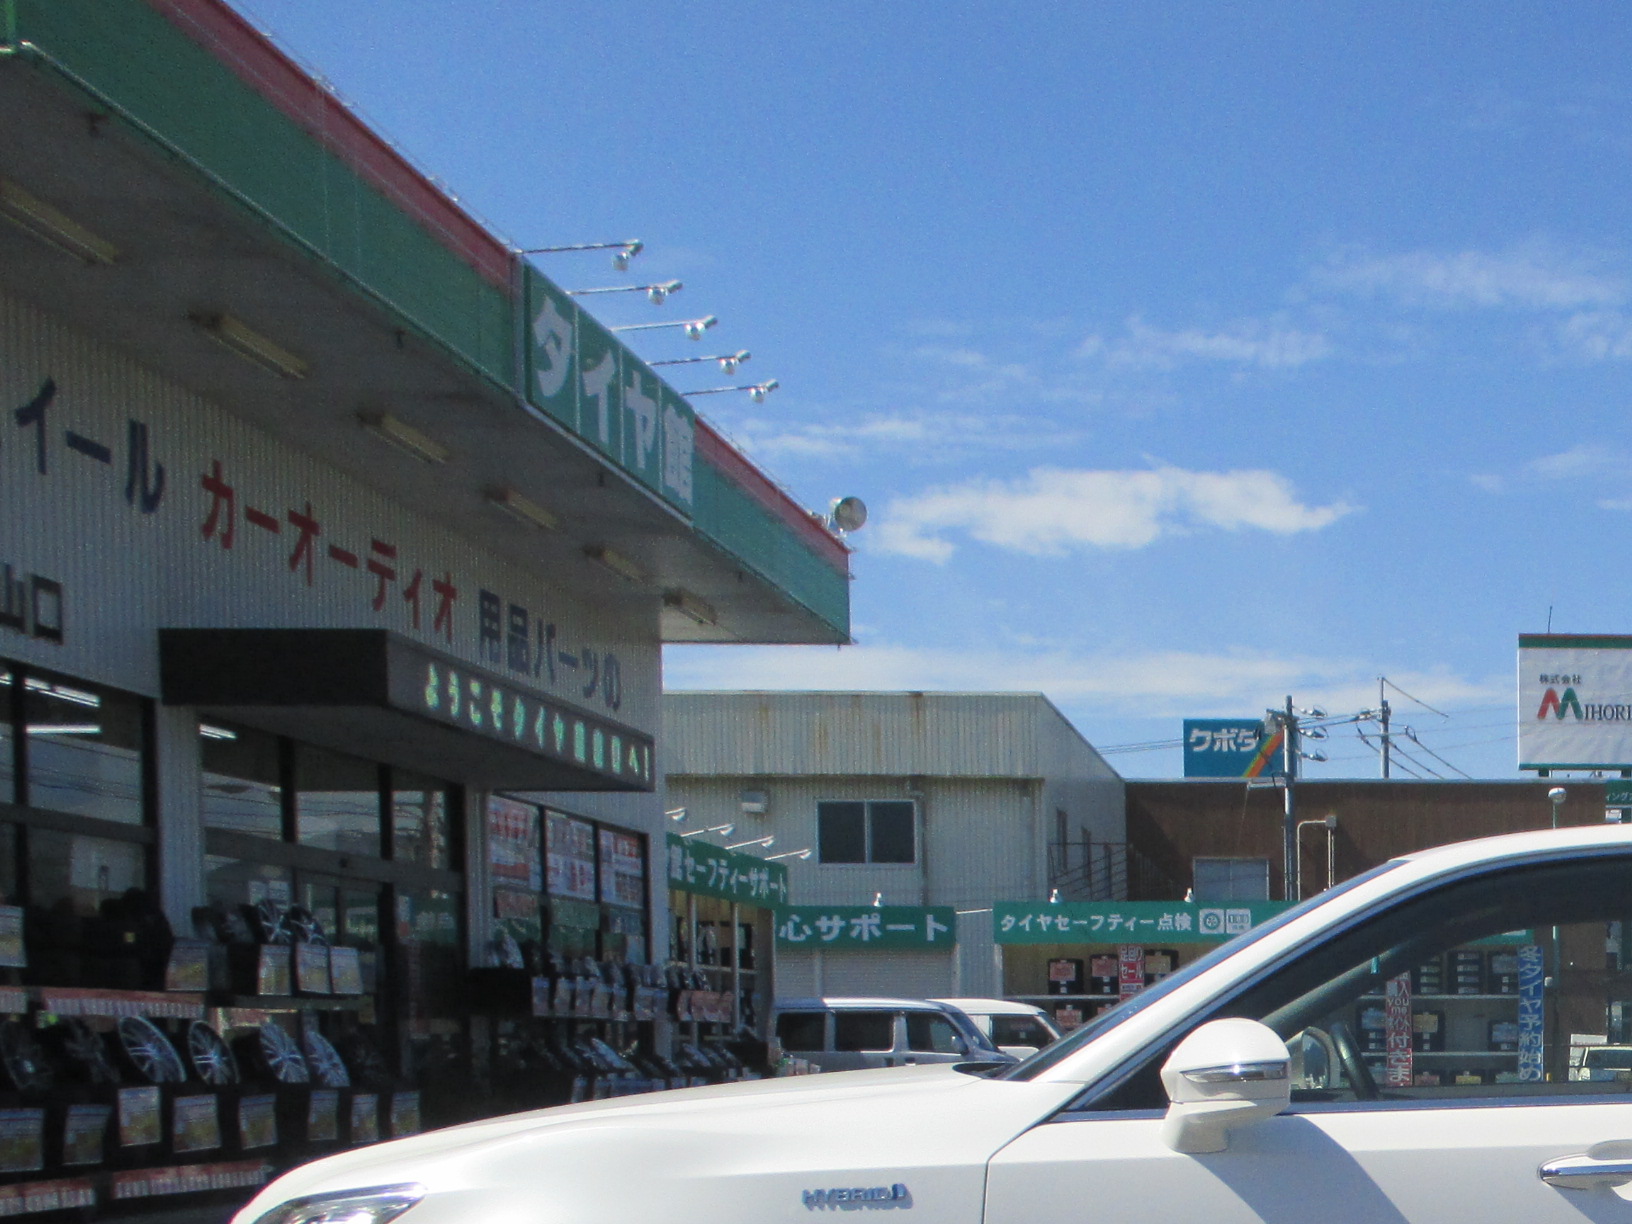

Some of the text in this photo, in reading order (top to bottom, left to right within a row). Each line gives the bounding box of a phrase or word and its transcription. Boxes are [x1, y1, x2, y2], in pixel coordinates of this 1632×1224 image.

[533, 294, 695, 506] タイヤ館
[14, 376, 166, 515] イール
[202, 459, 458, 644] カーオーディオ
[1539, 673, 1582, 685] 株式会社
[1537, 687, 1632, 721] MIHORI
[1189, 728, 1260, 752] クボタ
[779, 913, 948, 942] 心サポート
[1000, 912, 1192, 932] タイヤセーフティー点検
